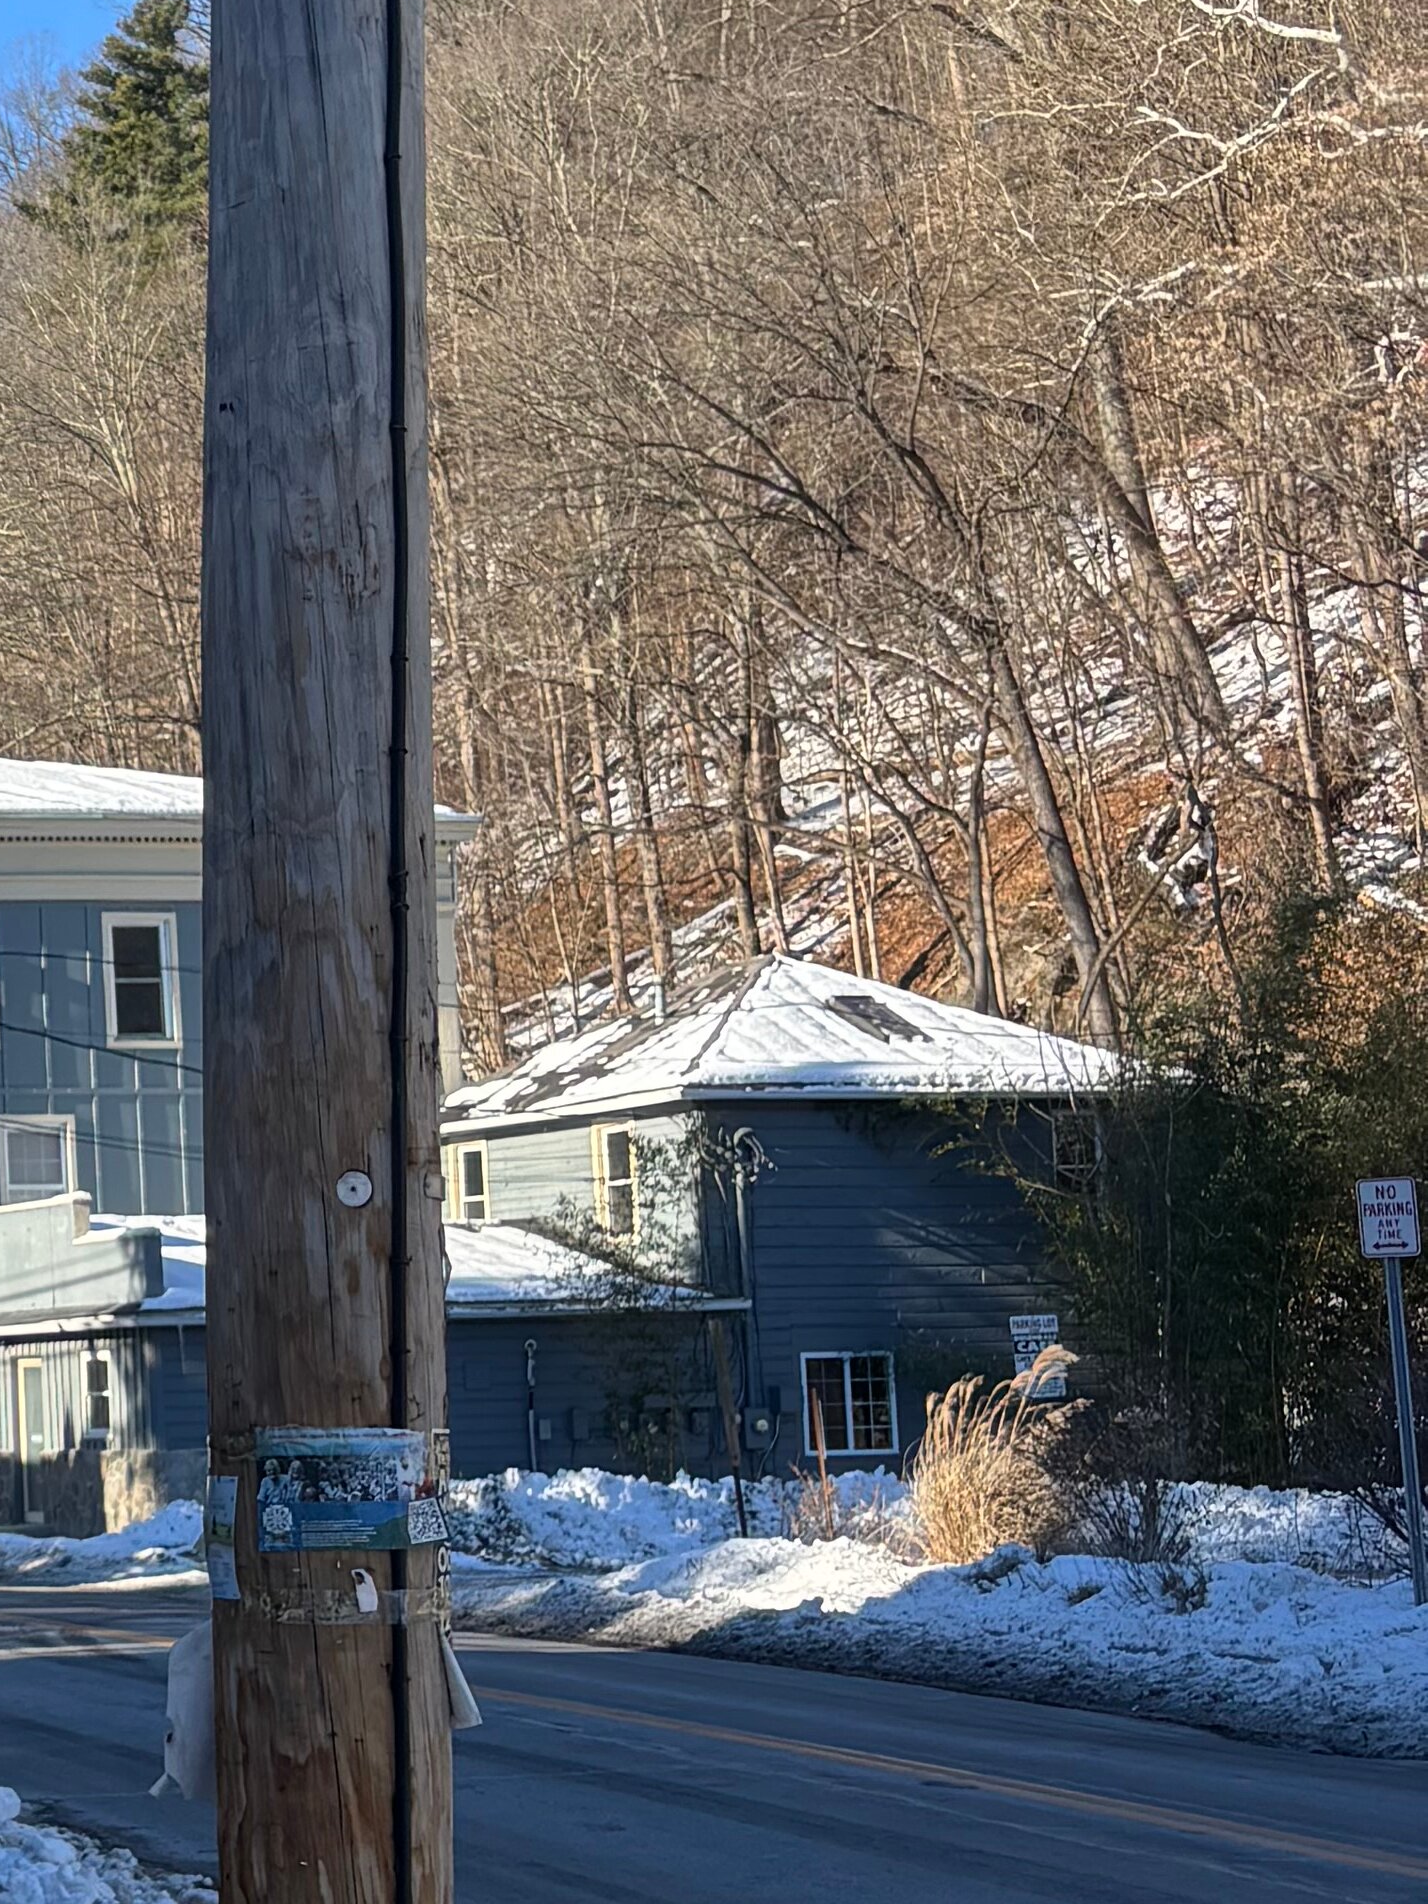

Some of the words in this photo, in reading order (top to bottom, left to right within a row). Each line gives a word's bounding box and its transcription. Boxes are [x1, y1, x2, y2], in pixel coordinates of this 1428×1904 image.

[1375, 1184, 1397, 1200] NO
[1363, 1201, 1413, 1217] PARKING
[1378, 1218, 1400, 1229] ANY
[1378, 1229, 1403, 1240] TIME
